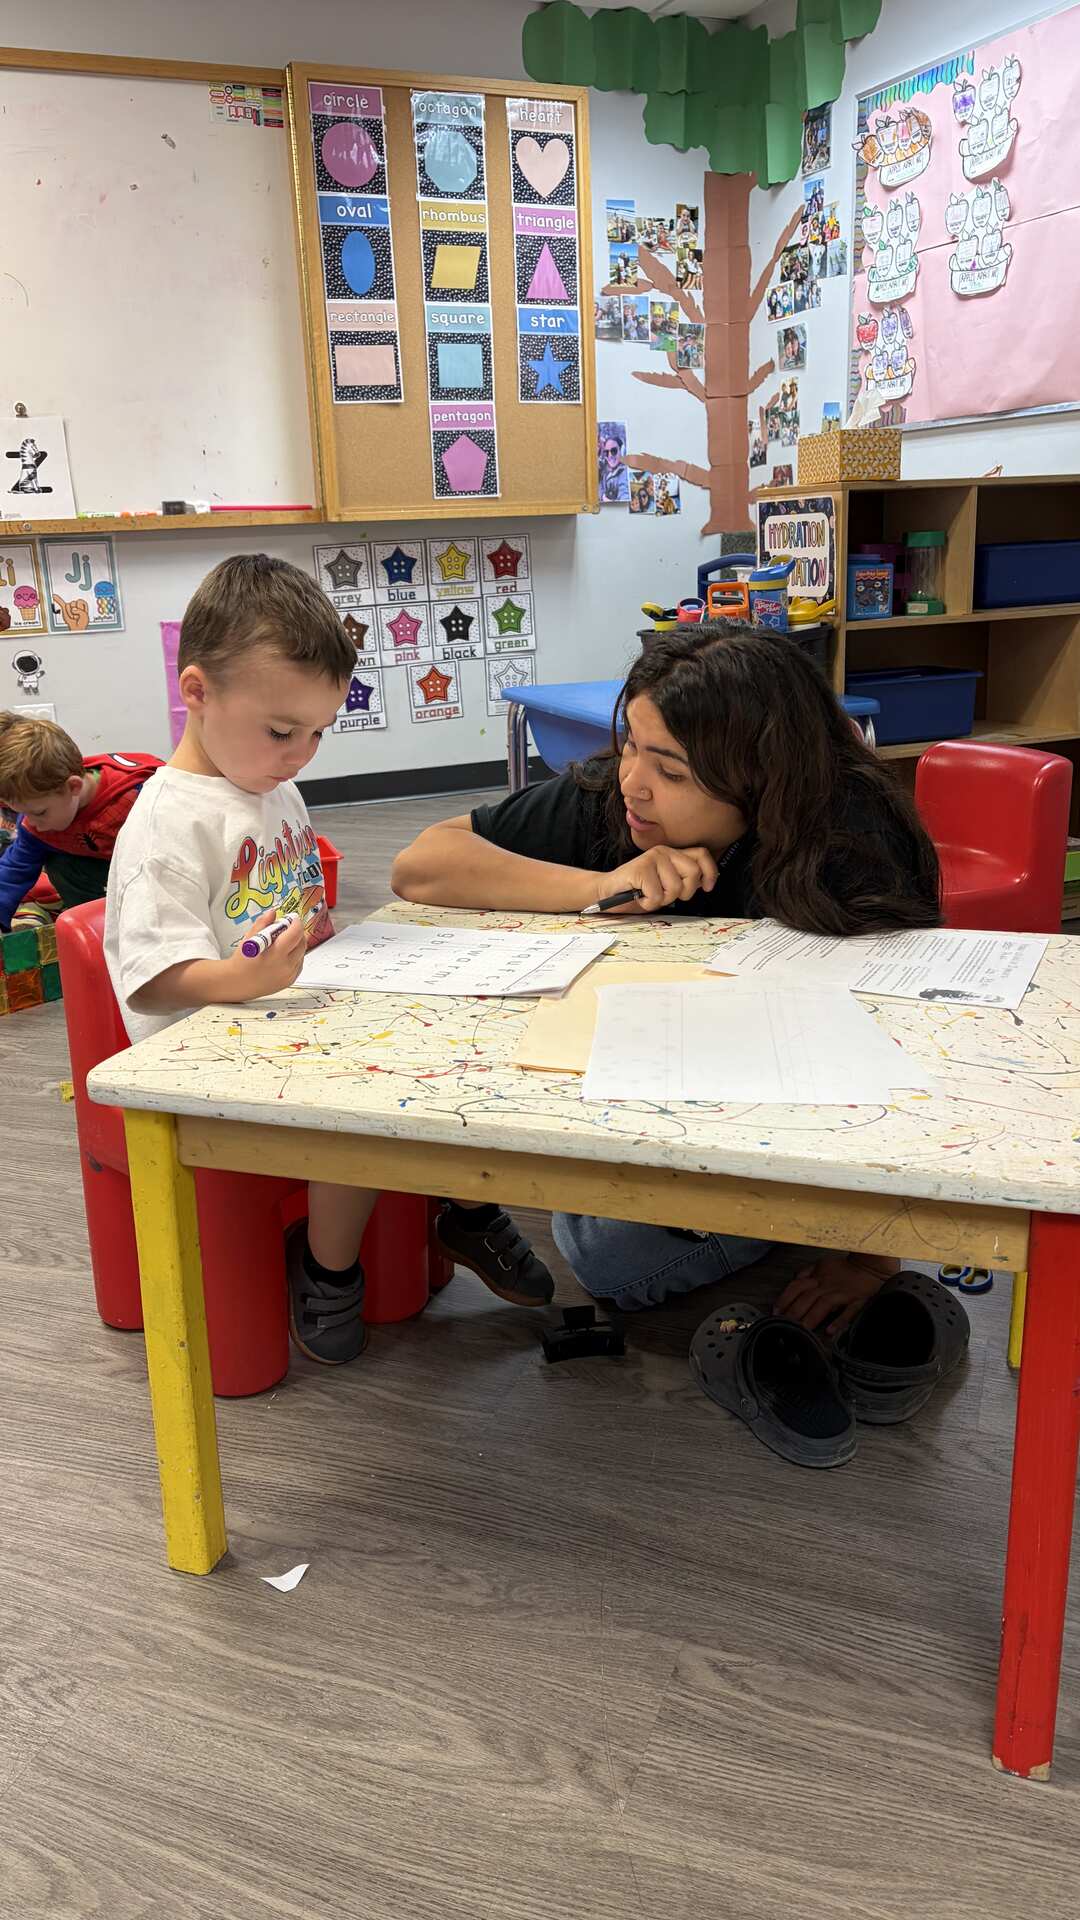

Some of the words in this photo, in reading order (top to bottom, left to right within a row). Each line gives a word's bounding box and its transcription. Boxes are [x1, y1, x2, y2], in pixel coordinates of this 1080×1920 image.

[323, 92, 369, 109] circle
[419, 102, 477, 118] octagon
[519, 108, 562, 124] heart
[336, 203, 372, 218] oval
[422, 209, 485, 223] rhombus
[517, 214, 575, 231] triangle
[330, 311, 395, 325] rectangle
[431, 313, 485, 326] square
[531, 314, 565, 327] star
[433, 411, 491, 424] pentagon
[768, 520, 825, 549] HYDRATION
[65, 552, 92, 591] Jj
[436, 585, 474, 598] yellow
[496, 581, 517, 593] red
[333, 594, 362, 608] grey
[388, 588, 416, 601] blue
[495, 639, 528, 652] green
[394, 648, 421, 664] pink
[443, 646, 477, 660] black
[415, 705, 460, 719] orange
[340, 715, 380, 731] purple
